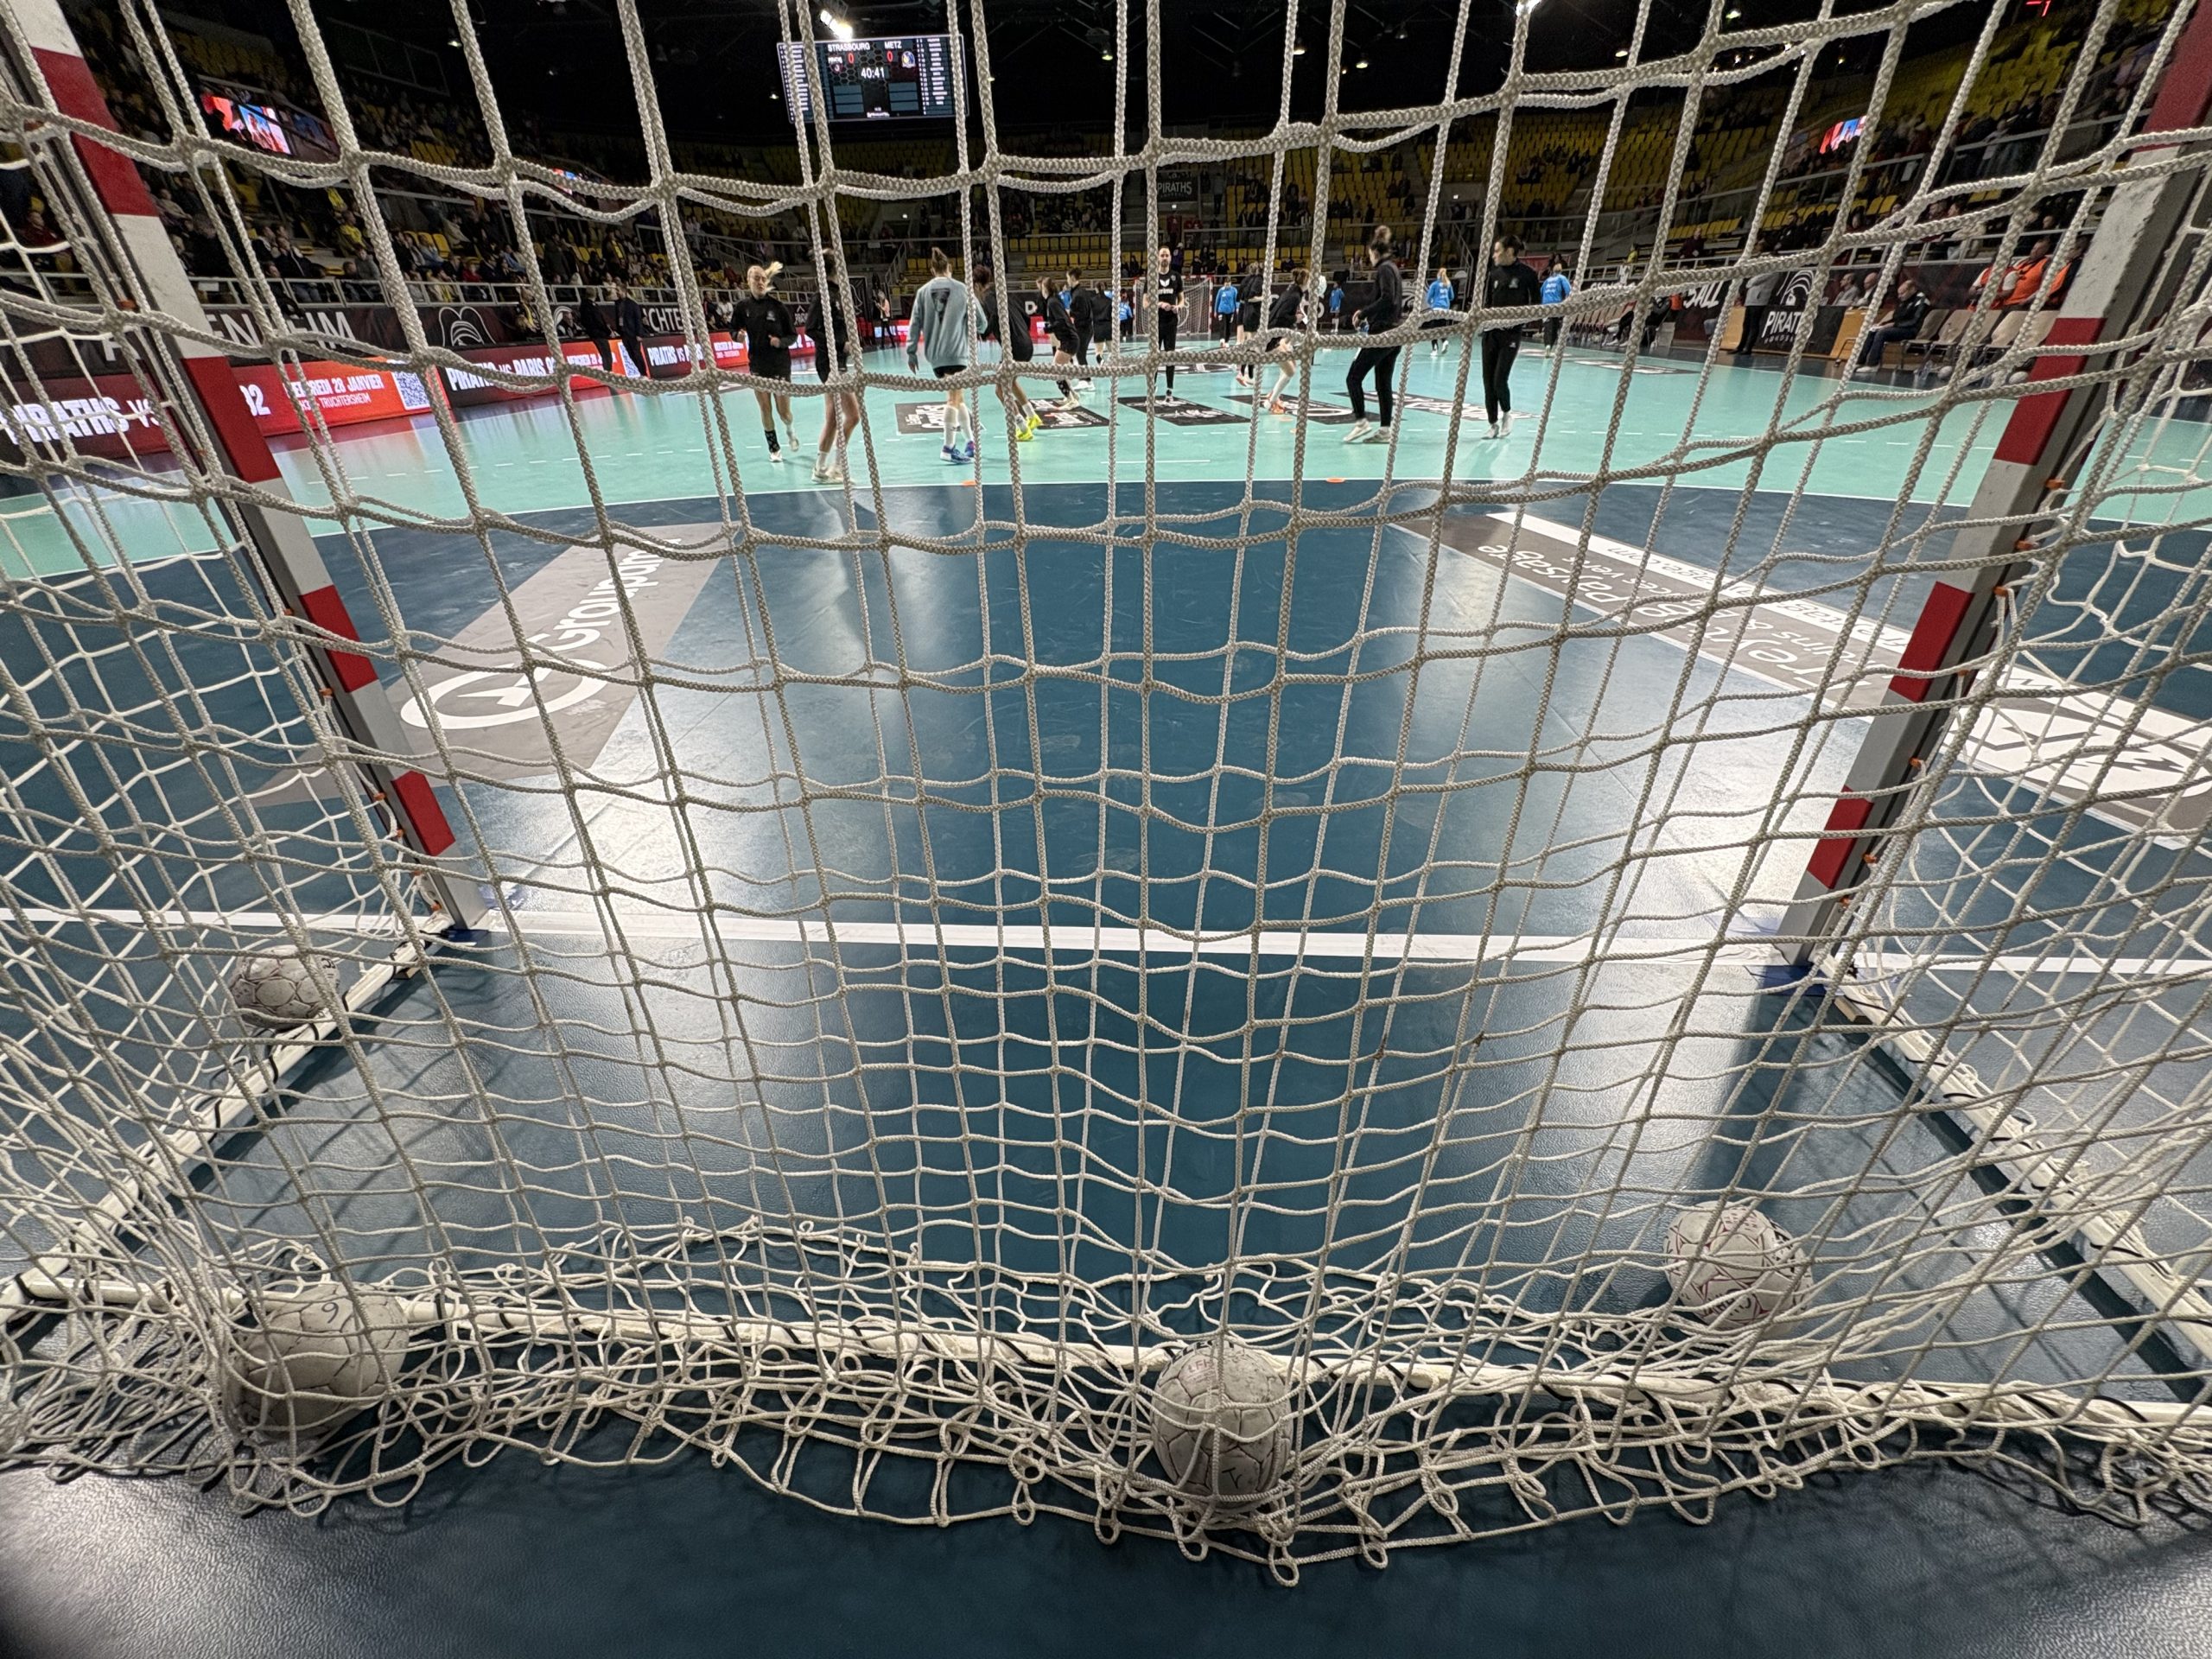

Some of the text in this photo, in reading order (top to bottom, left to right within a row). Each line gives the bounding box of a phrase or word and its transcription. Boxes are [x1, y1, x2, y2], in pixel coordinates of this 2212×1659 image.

[828, 41, 870, 52] STRASBOURG
[884, 41, 901, 49] METZ
[848, 52, 855, 64] 0
[887, 51, 893, 63] 0
[861, 67, 885, 79] 40:41
[1157, 181, 1192, 195] PIRATHS
[1762, 311, 1803, 338] PIRAT
[346, 374, 385, 392] JANVIER
[1562, 556, 1625, 579] vers
